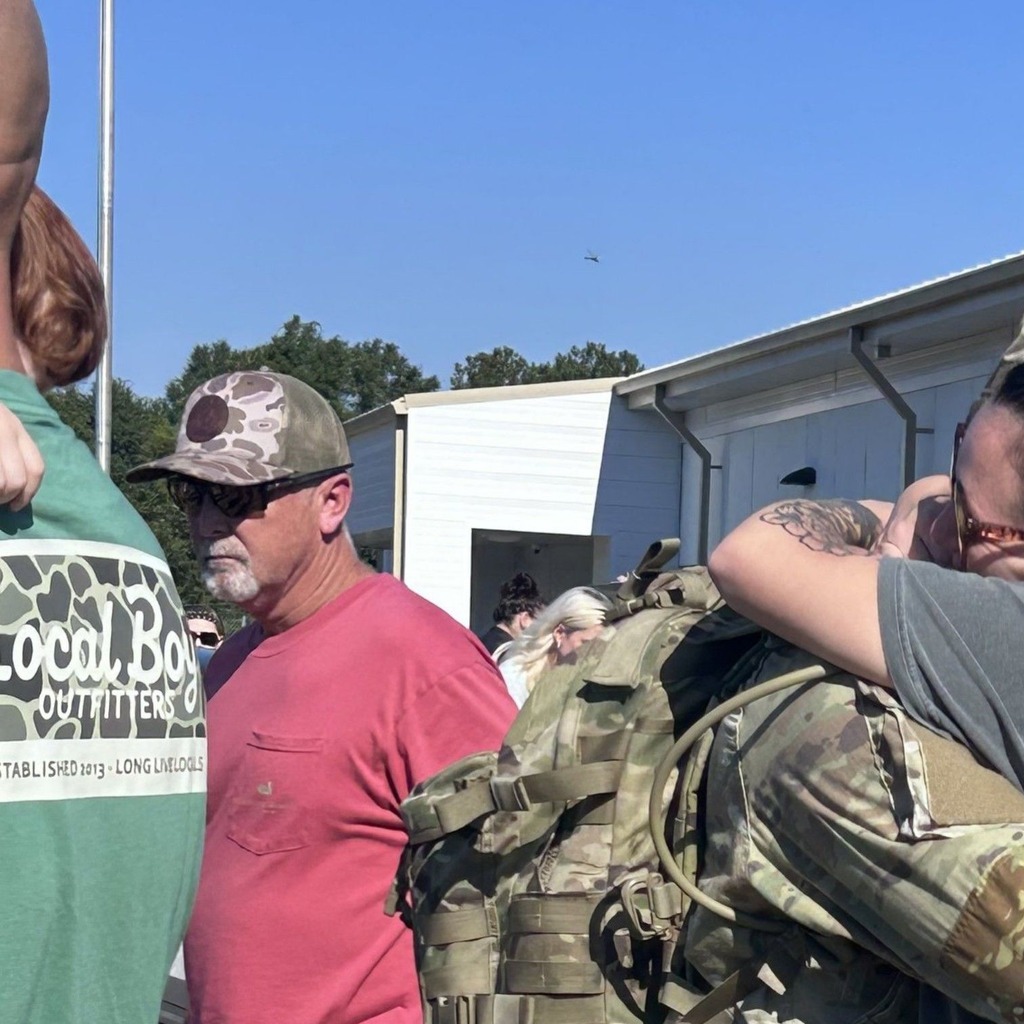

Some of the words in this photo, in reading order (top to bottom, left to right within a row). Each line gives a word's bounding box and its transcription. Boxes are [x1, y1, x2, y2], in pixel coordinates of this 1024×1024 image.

[123, 584, 198, 713] Boy
[38, 688, 175, 719] OUTFITTERS
[0, 760, 78, 778] TABLISHED
[80, 763, 105, 780] 2013
[116, 758, 151, 775] LONG
